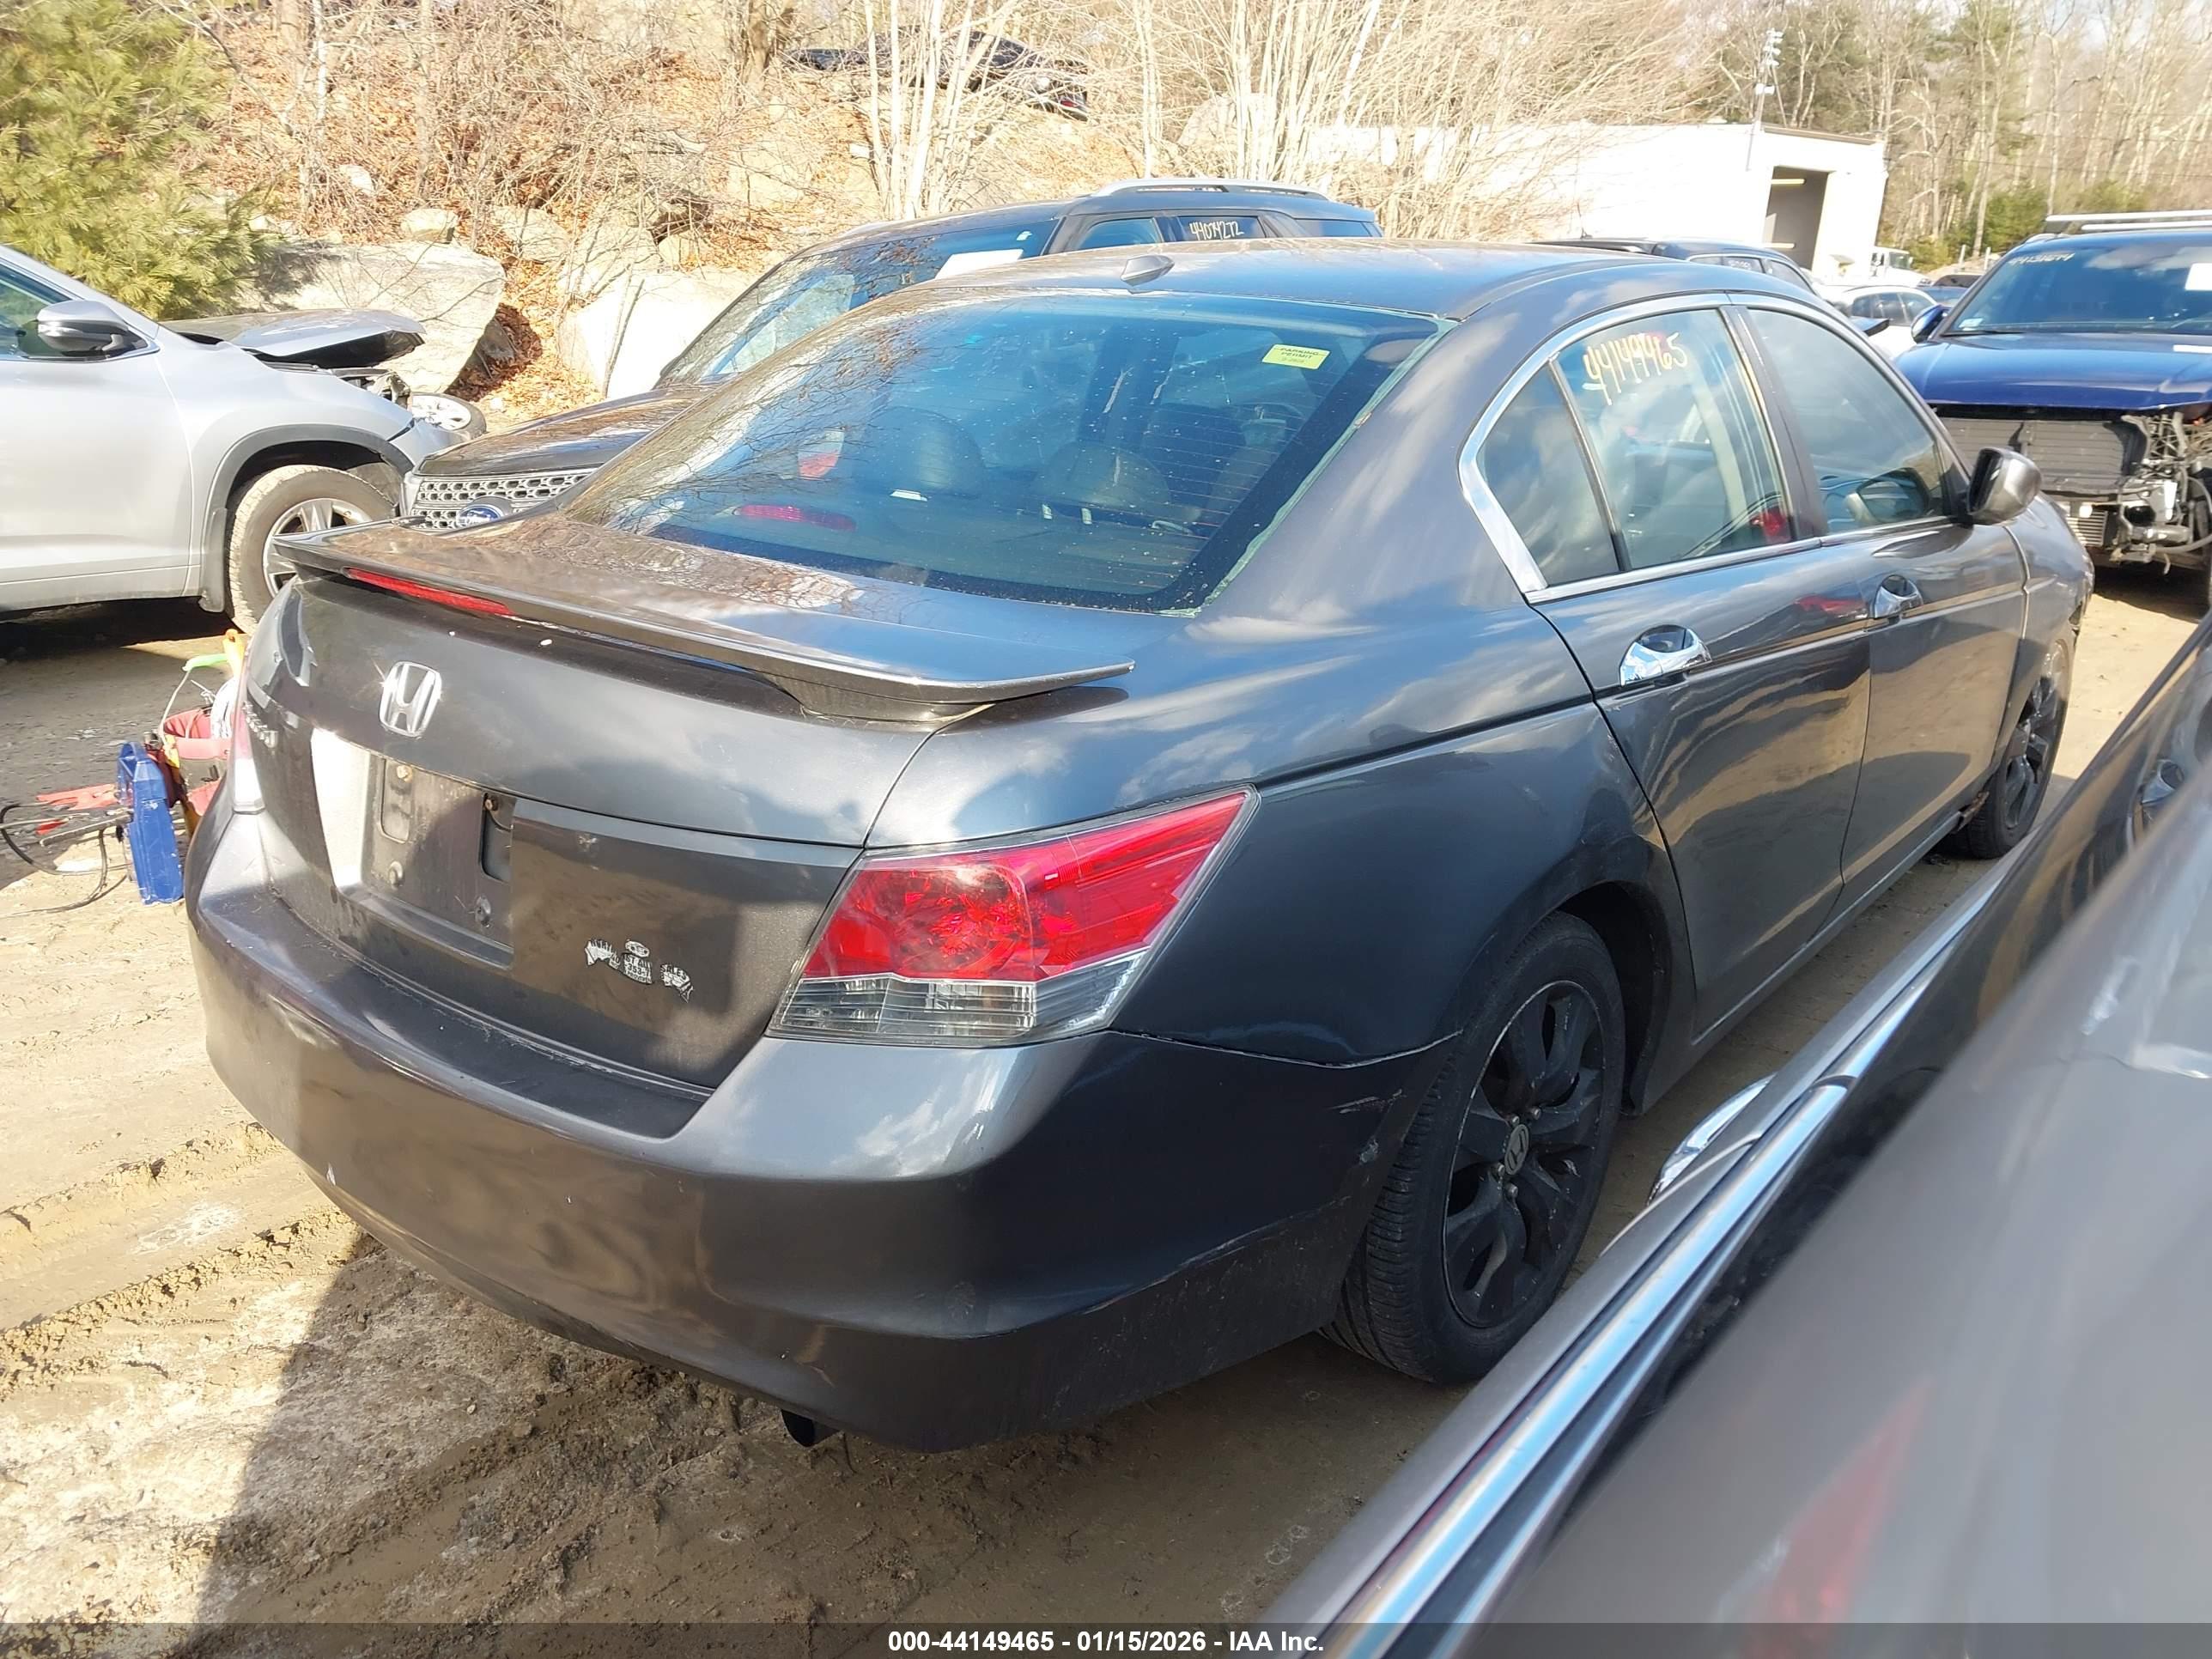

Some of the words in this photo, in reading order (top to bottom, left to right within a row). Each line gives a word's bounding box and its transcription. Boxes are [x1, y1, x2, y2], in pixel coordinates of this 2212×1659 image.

[1279, 347, 1320, 356] PARKING
[1280, 351, 1314, 360] PERMIT
[1582, 331, 1688, 406] 44149465
